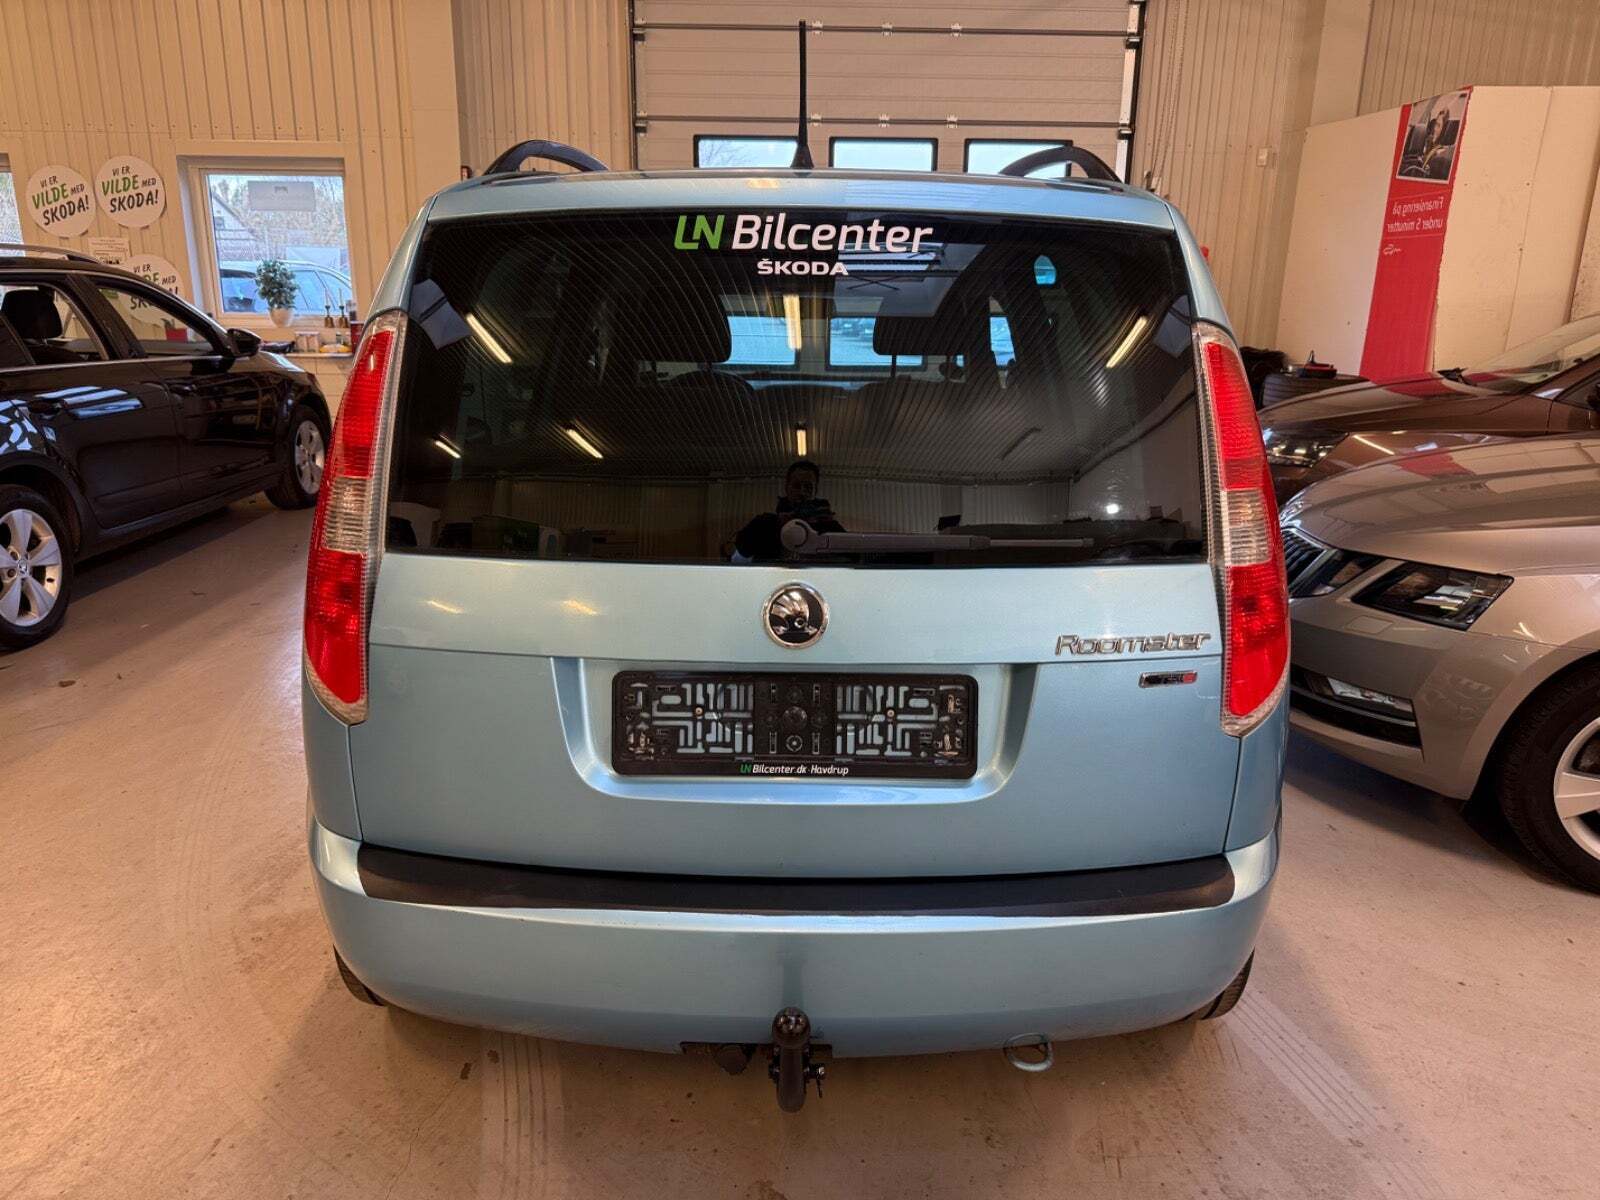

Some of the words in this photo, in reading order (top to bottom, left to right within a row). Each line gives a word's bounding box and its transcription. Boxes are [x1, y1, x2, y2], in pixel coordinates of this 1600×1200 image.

[112, 167, 119, 176] VI
[121, 165, 130, 175] ER
[40, 179, 48, 188] VI
[49, 175, 58, 186] ER
[101, 174, 139, 197] VILDE
[141, 177, 156, 188] MED
[32, 183, 69, 209] VILDE
[70, 183, 85, 195] MED
[110, 189, 159, 213] SKODA!
[42, 194, 89, 226] SKODA!
[674, 214, 725, 250] LN
[731, 212, 934, 253] Bilcenter
[133, 265, 141, 273] VI
[142, 263, 152, 273] ER
[756, 258, 849, 276] ŠKODA
[162, 275, 177, 286] MED
[1055, 631, 1211, 656] Roomster
[810, 764, 849, 776] Havdrup
